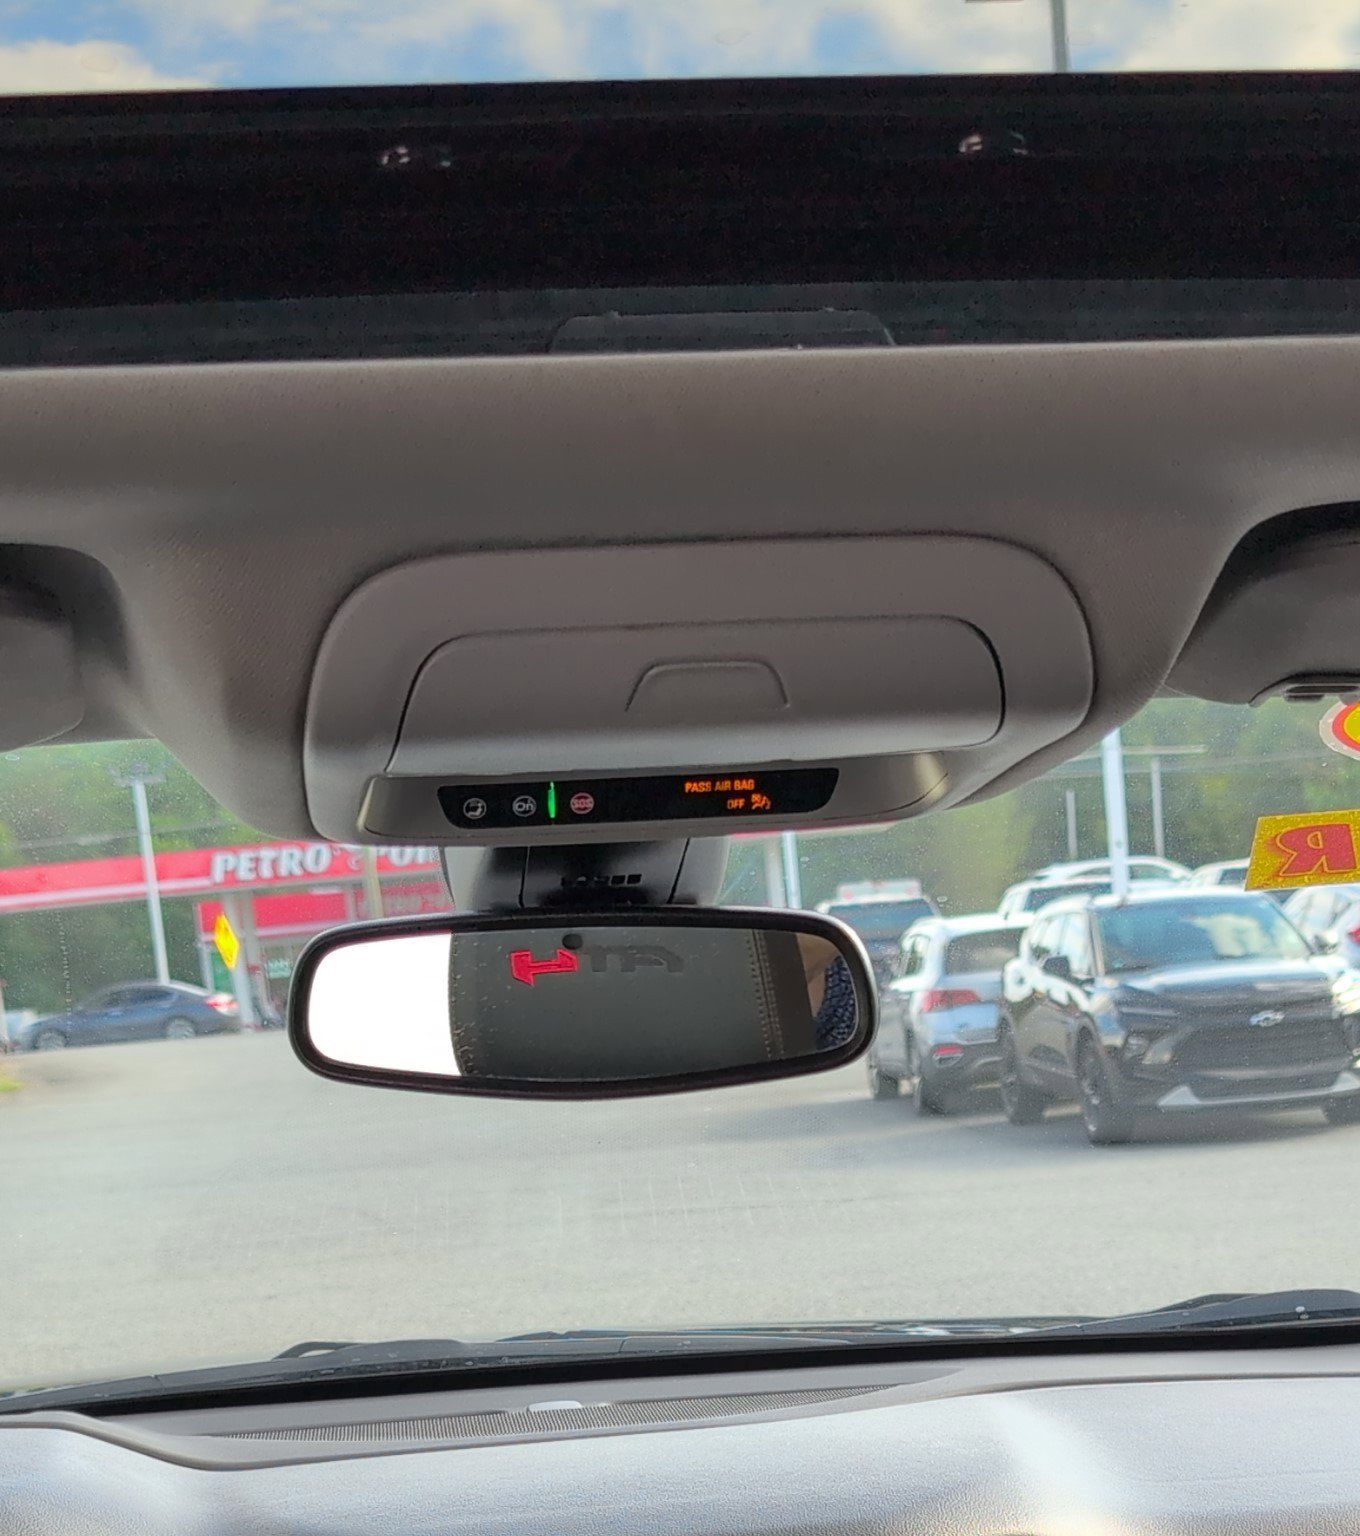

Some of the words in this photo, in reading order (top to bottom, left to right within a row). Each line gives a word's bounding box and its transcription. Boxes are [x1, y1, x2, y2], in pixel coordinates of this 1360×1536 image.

[684, 780, 712, 793] PASS
[714, 780, 732, 792] AIR
[734, 778, 756, 791] BAG
[572, 798, 593, 810] SOS
[727, 798, 746, 810] OFF
[211, 843, 332, 883] PETRO
